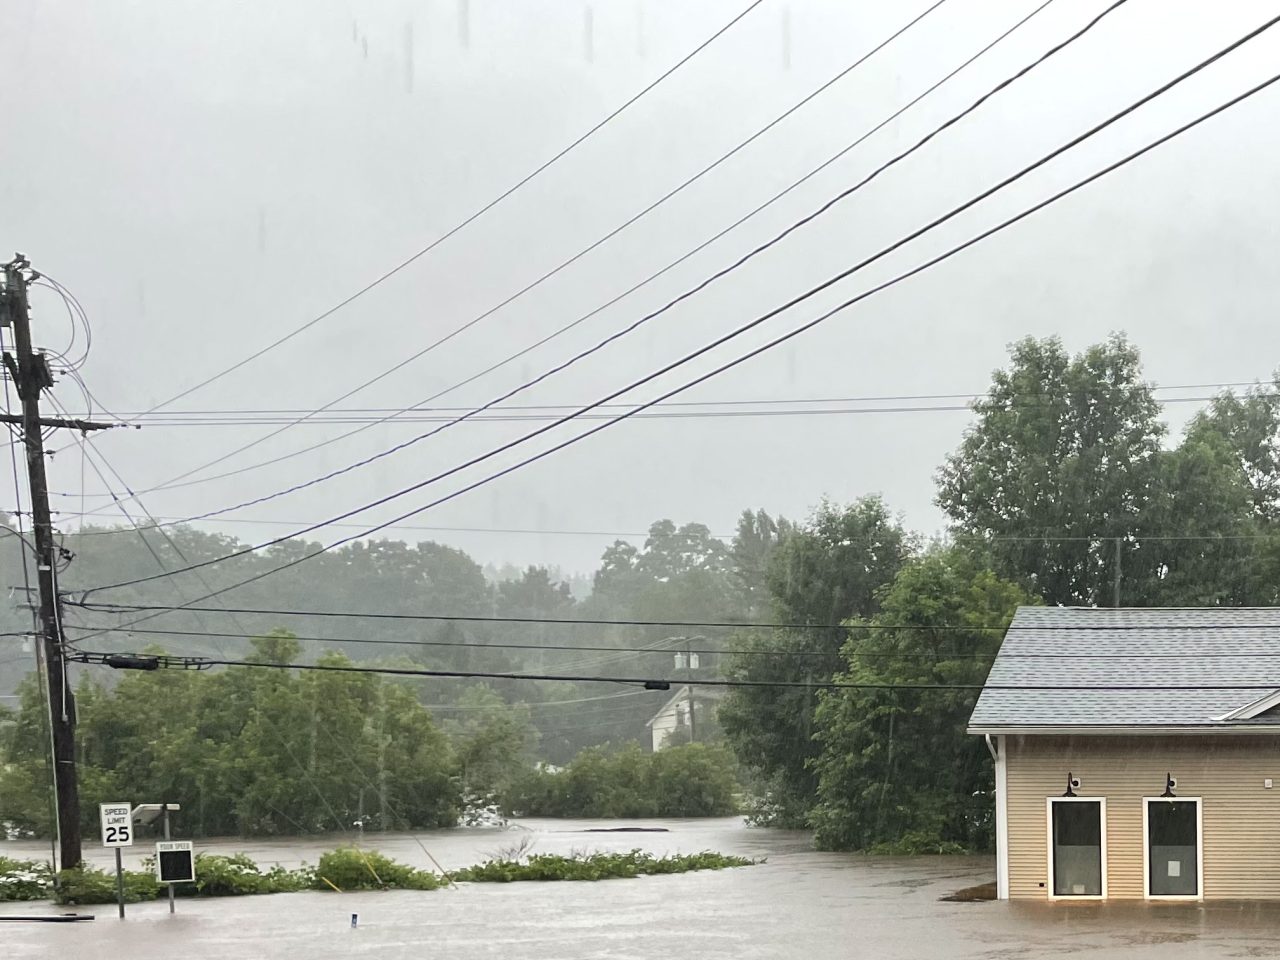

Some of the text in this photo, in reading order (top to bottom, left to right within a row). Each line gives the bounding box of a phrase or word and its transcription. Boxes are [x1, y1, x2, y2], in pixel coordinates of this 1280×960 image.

[104, 808, 128, 816] SPEED
[107, 816, 126, 825] LIMIT
[105, 826, 130, 843] 25
[174, 842, 190, 850] SPEED
